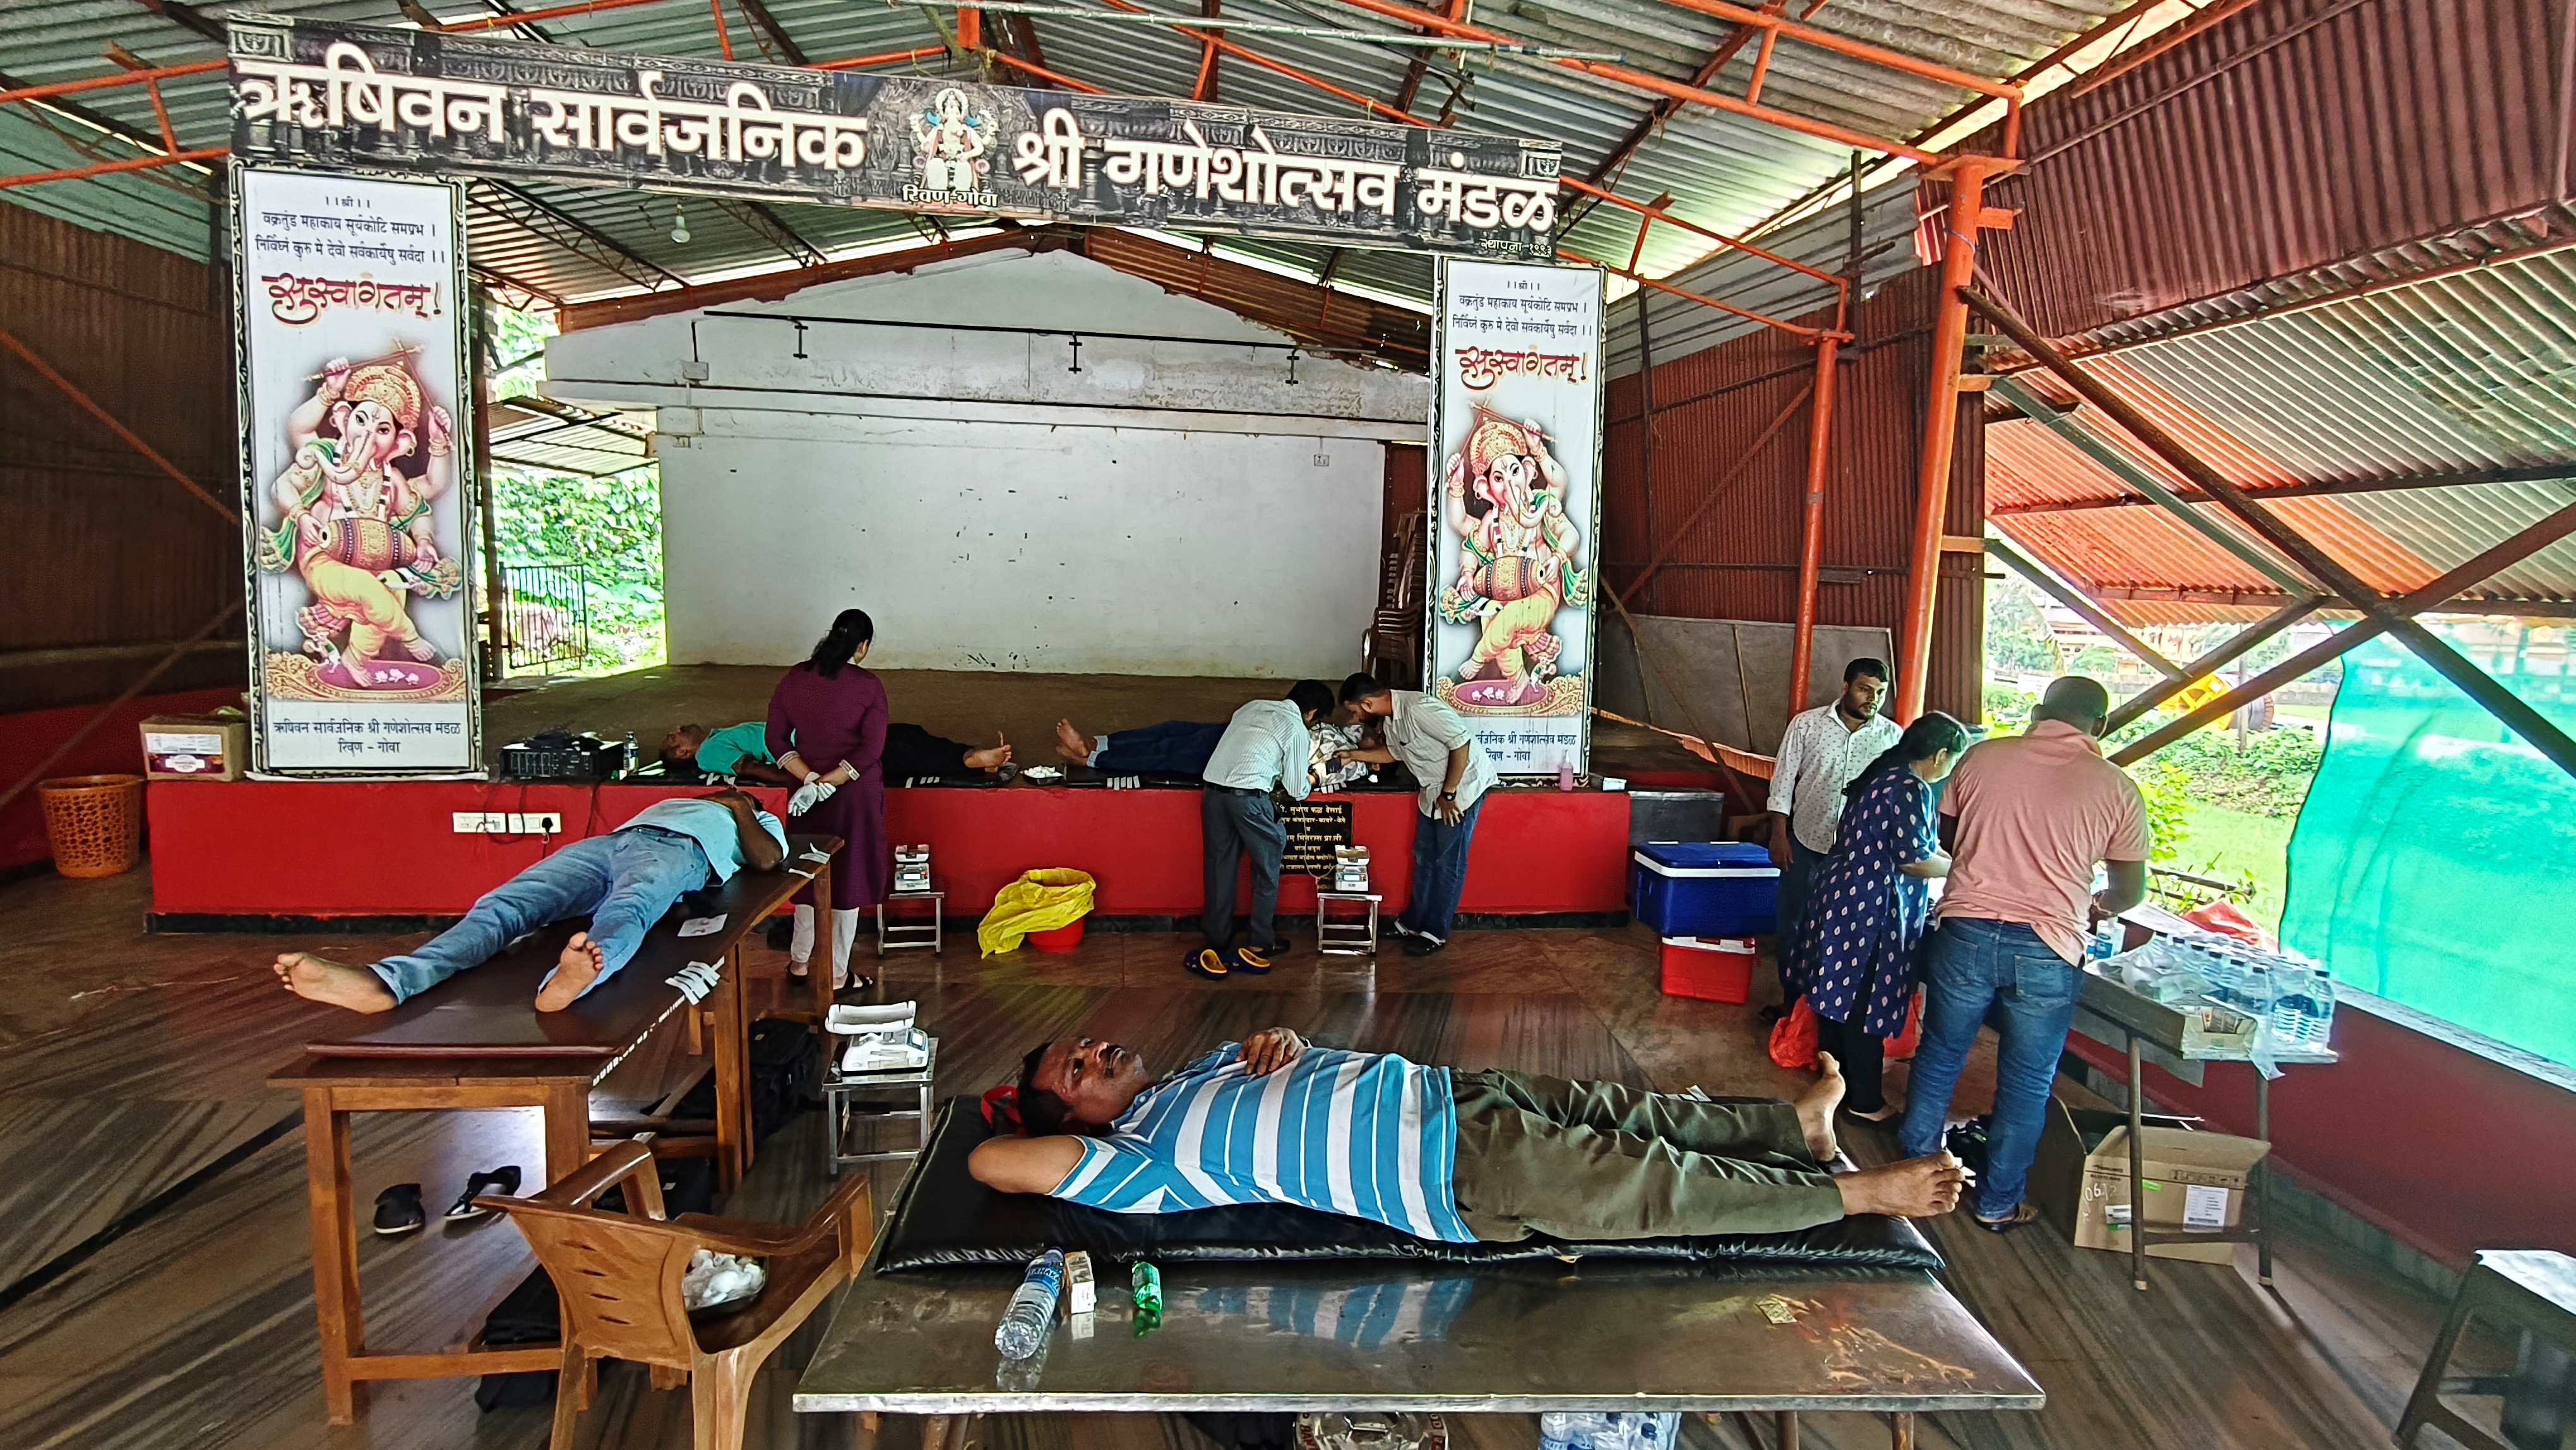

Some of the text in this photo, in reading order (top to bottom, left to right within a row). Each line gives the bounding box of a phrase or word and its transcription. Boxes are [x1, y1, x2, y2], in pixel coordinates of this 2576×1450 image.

[236, 42, 1559, 233] ऋषिवन सार्वजनिक श्री गणेशोत्सव मंडळ
[261, 210, 297, 231] वक्रतुंड
[300, 215, 342, 230] महाकाय
[345, 214, 387, 236] सूर्यकोटि
[390, 222, 424, 236] समप्रभ
[315, 238, 323, 255] मे
[398, 244, 425, 263] सर्वदा
[1459, 293, 1484, 311] वक्रतुंड
[1487, 297, 1517, 309] महाकाय
[1520, 295, 1552, 314] सूर्यकोटि
[1554, 301, 1578, 313] समप्रभ
[1558, 320, 1577, 337] सर्वदा
[313, 718, 364, 734] सार्वजनिक
[367, 719, 379, 734] श्री
[383, 718, 432, 734] गणेशोत्सव
[434, 720, 462, 734] मंडळ
[378, 738, 401, 753] गोवा
[1508, 731, 1517, 745] श्री
